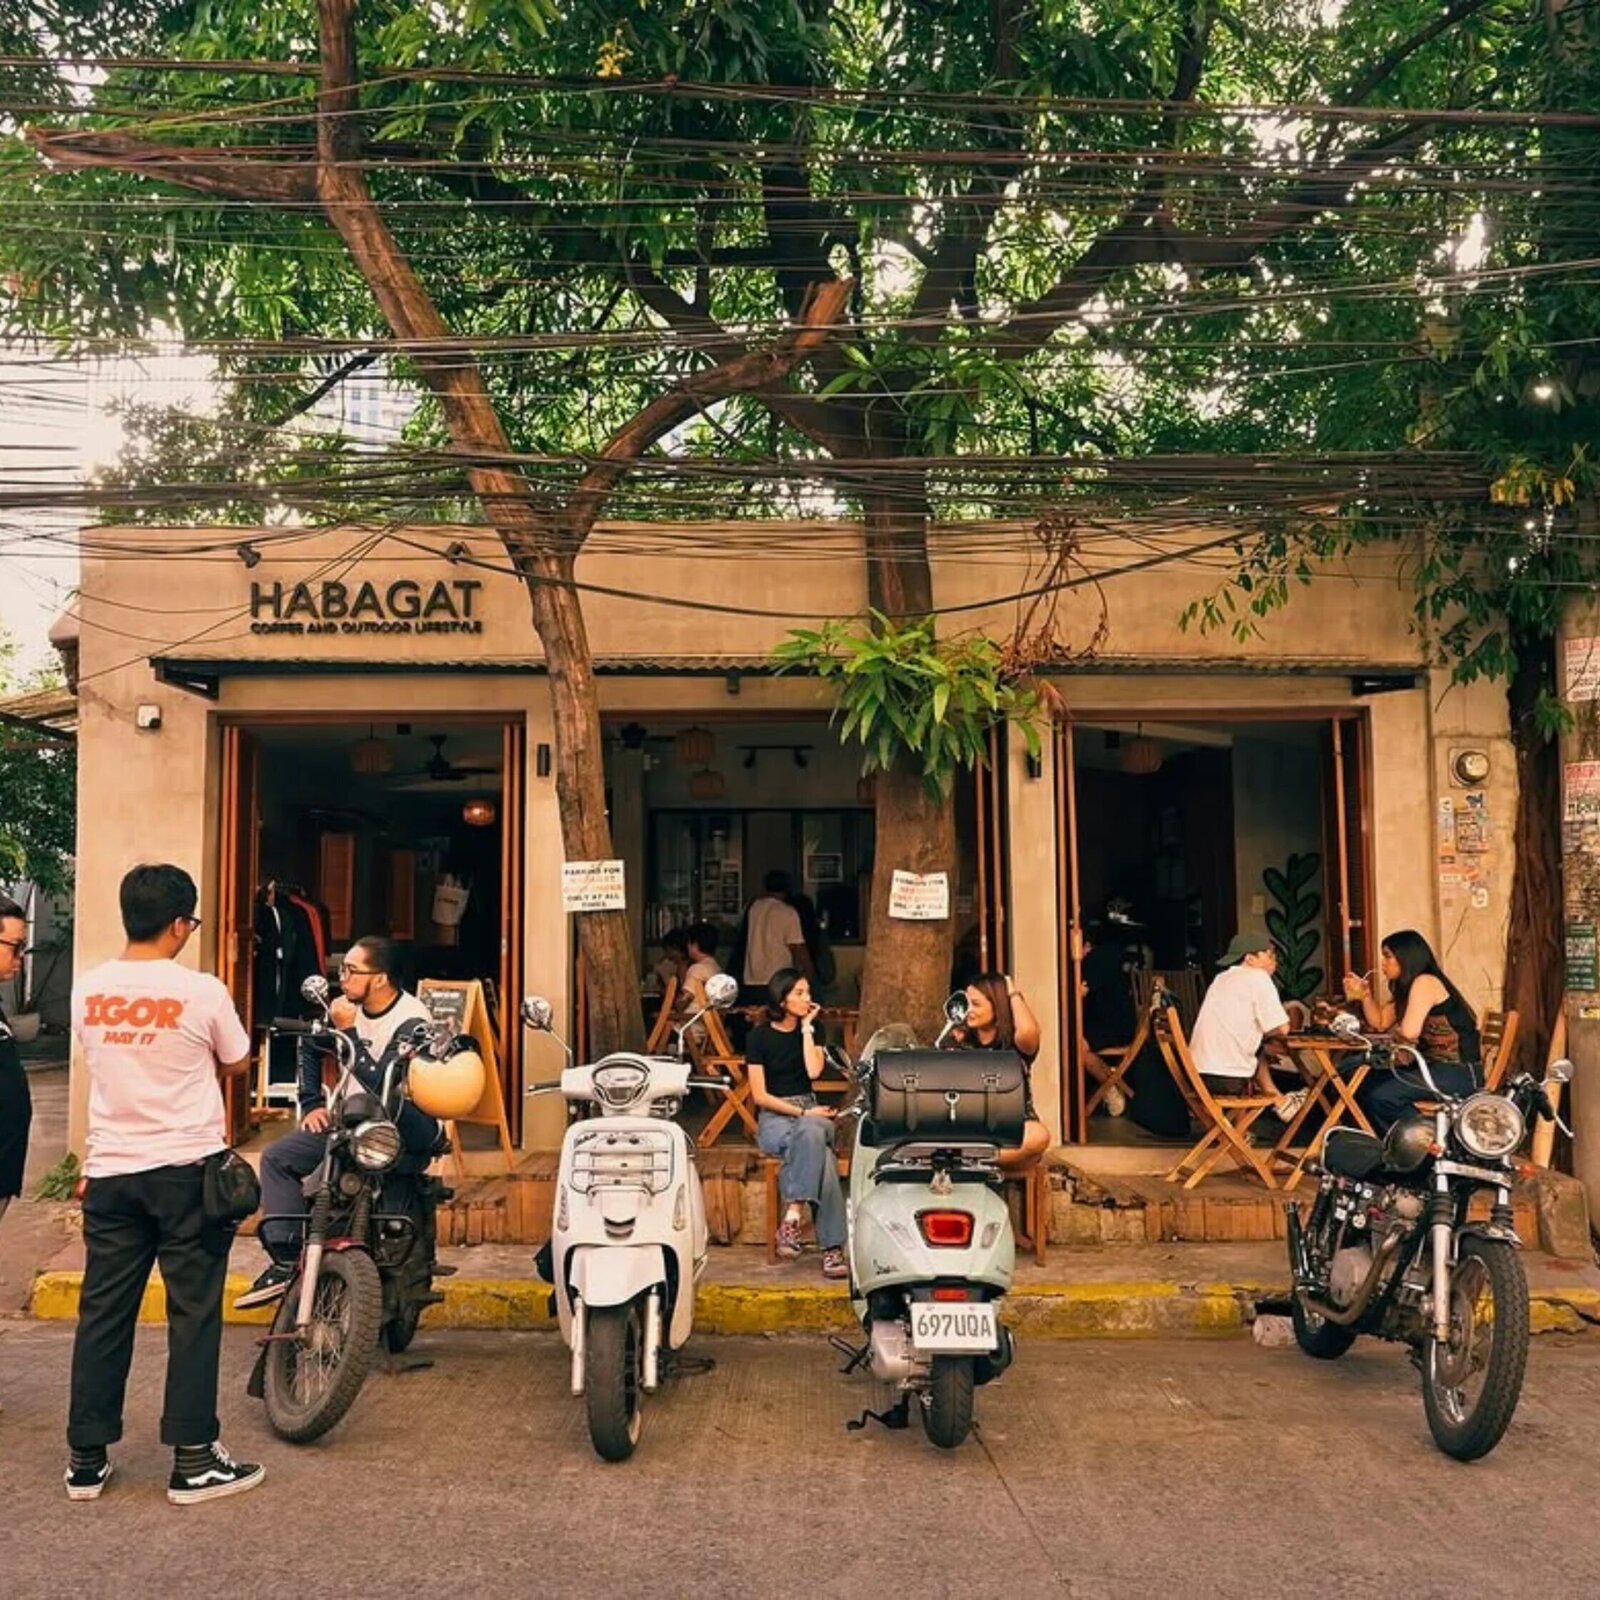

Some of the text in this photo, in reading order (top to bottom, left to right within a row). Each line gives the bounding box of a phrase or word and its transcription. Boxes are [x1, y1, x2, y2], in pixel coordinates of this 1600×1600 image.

[251, 580, 481, 619] HABAGAT
[251, 621, 482, 635] COFFEE AND OUTDOOR LIFESTYLE
[84, 993, 183, 1030] IGOR
[103, 1031, 156, 1045] MAY 17
[917, 1314, 992, 1338] 697UQA
